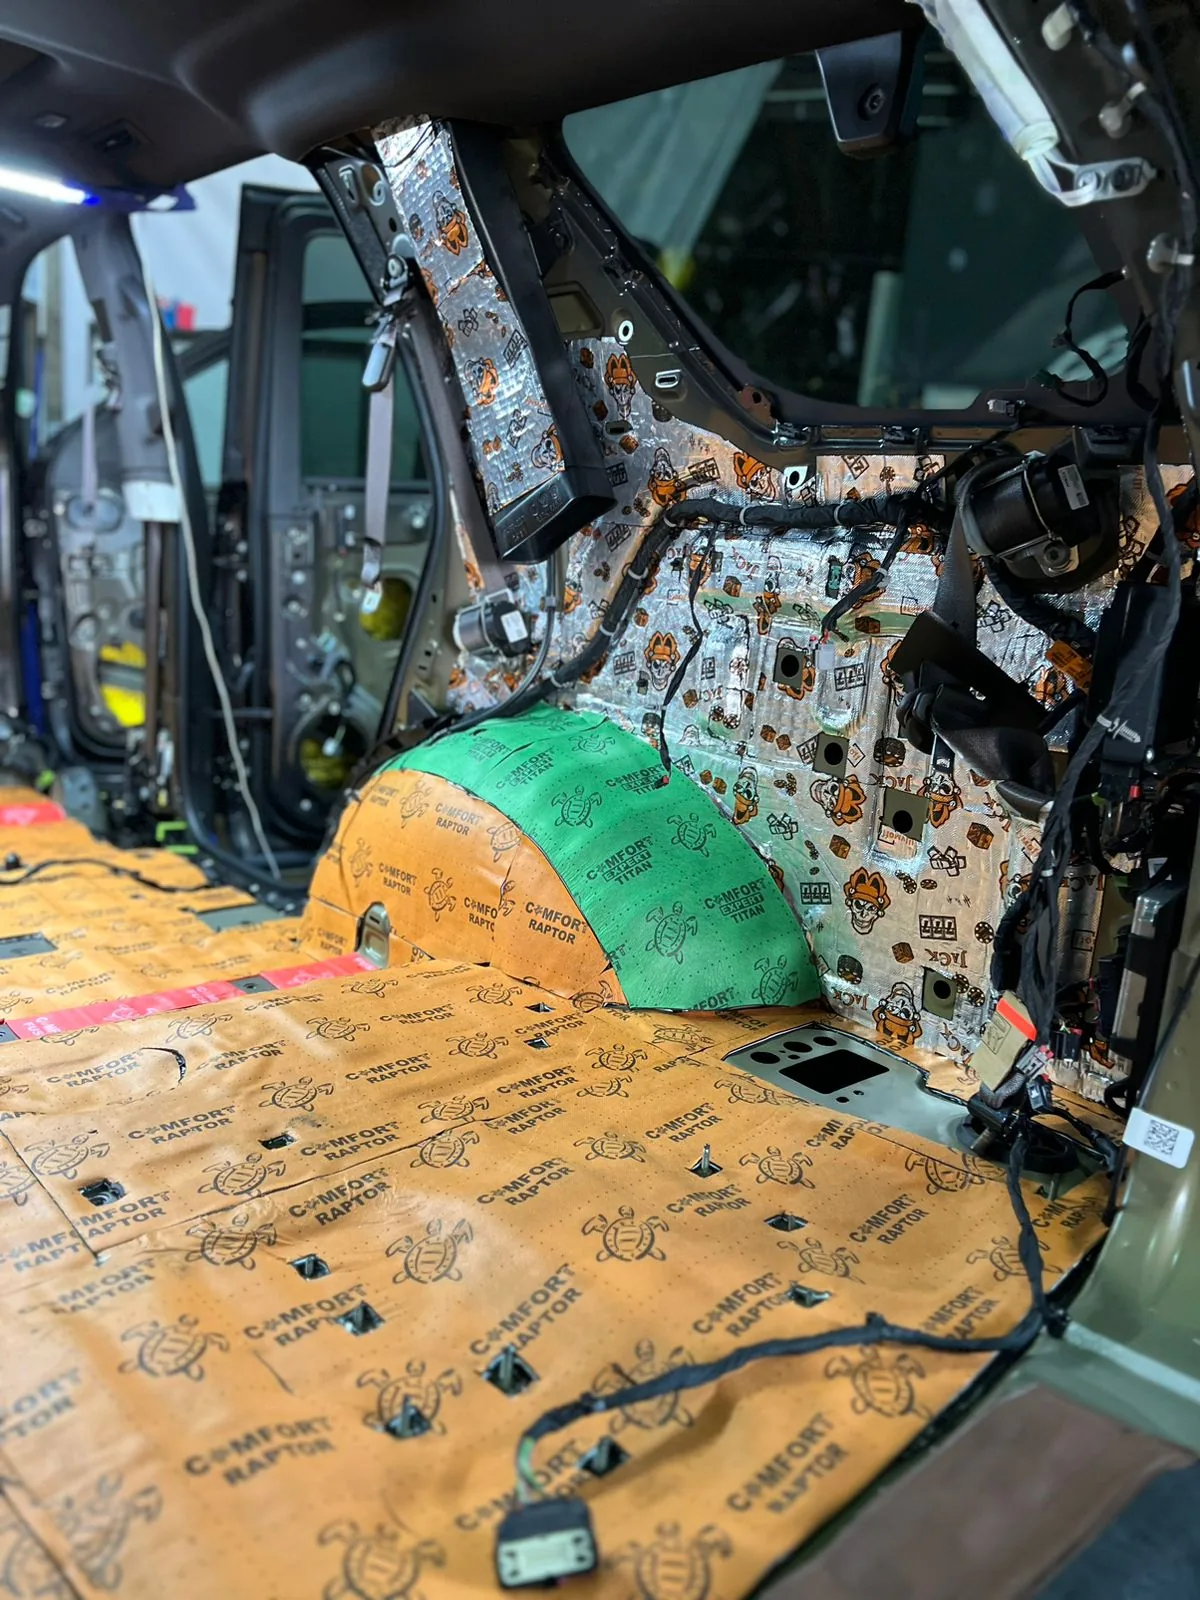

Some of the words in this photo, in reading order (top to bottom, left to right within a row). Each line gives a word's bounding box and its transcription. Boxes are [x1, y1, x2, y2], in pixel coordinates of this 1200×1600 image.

[436, 817, 470, 836] RAPTOR
[586, 835, 653, 881] COMFORT
[602, 848, 652, 882] EXPERT
[383, 876, 412, 896] RAPTOR
[616, 862, 653, 885] TITAN
[704, 877, 767, 910] COMFORT
[719, 892, 764, 916] EXPERT
[730, 904, 766, 924] TITAN
[528, 918, 577, 945] RAPTOR
[925, 947, 969, 970] JACK
[830, 985, 871, 1013] JACK
[399, 1011, 455, 1026] RAPTOR
[534, 1019, 587, 1039] RAPTOR
[214, 1048, 285, 1071] RAPTOR
[65, 1061, 142, 1088] RAPTOR
[367, 1063, 432, 1085] RAPTOR
[519, 1076, 579, 1099] RAPTOR
[151, 1117, 234, 1145] RAPTOR
[507, 1106, 567, 1136] RAPTOR
[667, 1115, 724, 1143] RAPTOR
[324, 1133, 400, 1161] RAPTOR
[504, 1166, 577, 1206] RAPTOR
[314, 1181, 391, 1226] RAPTOR
[88, 1207, 167, 1239] APTOR
[877, 1207, 930, 1245] RAPTOR
